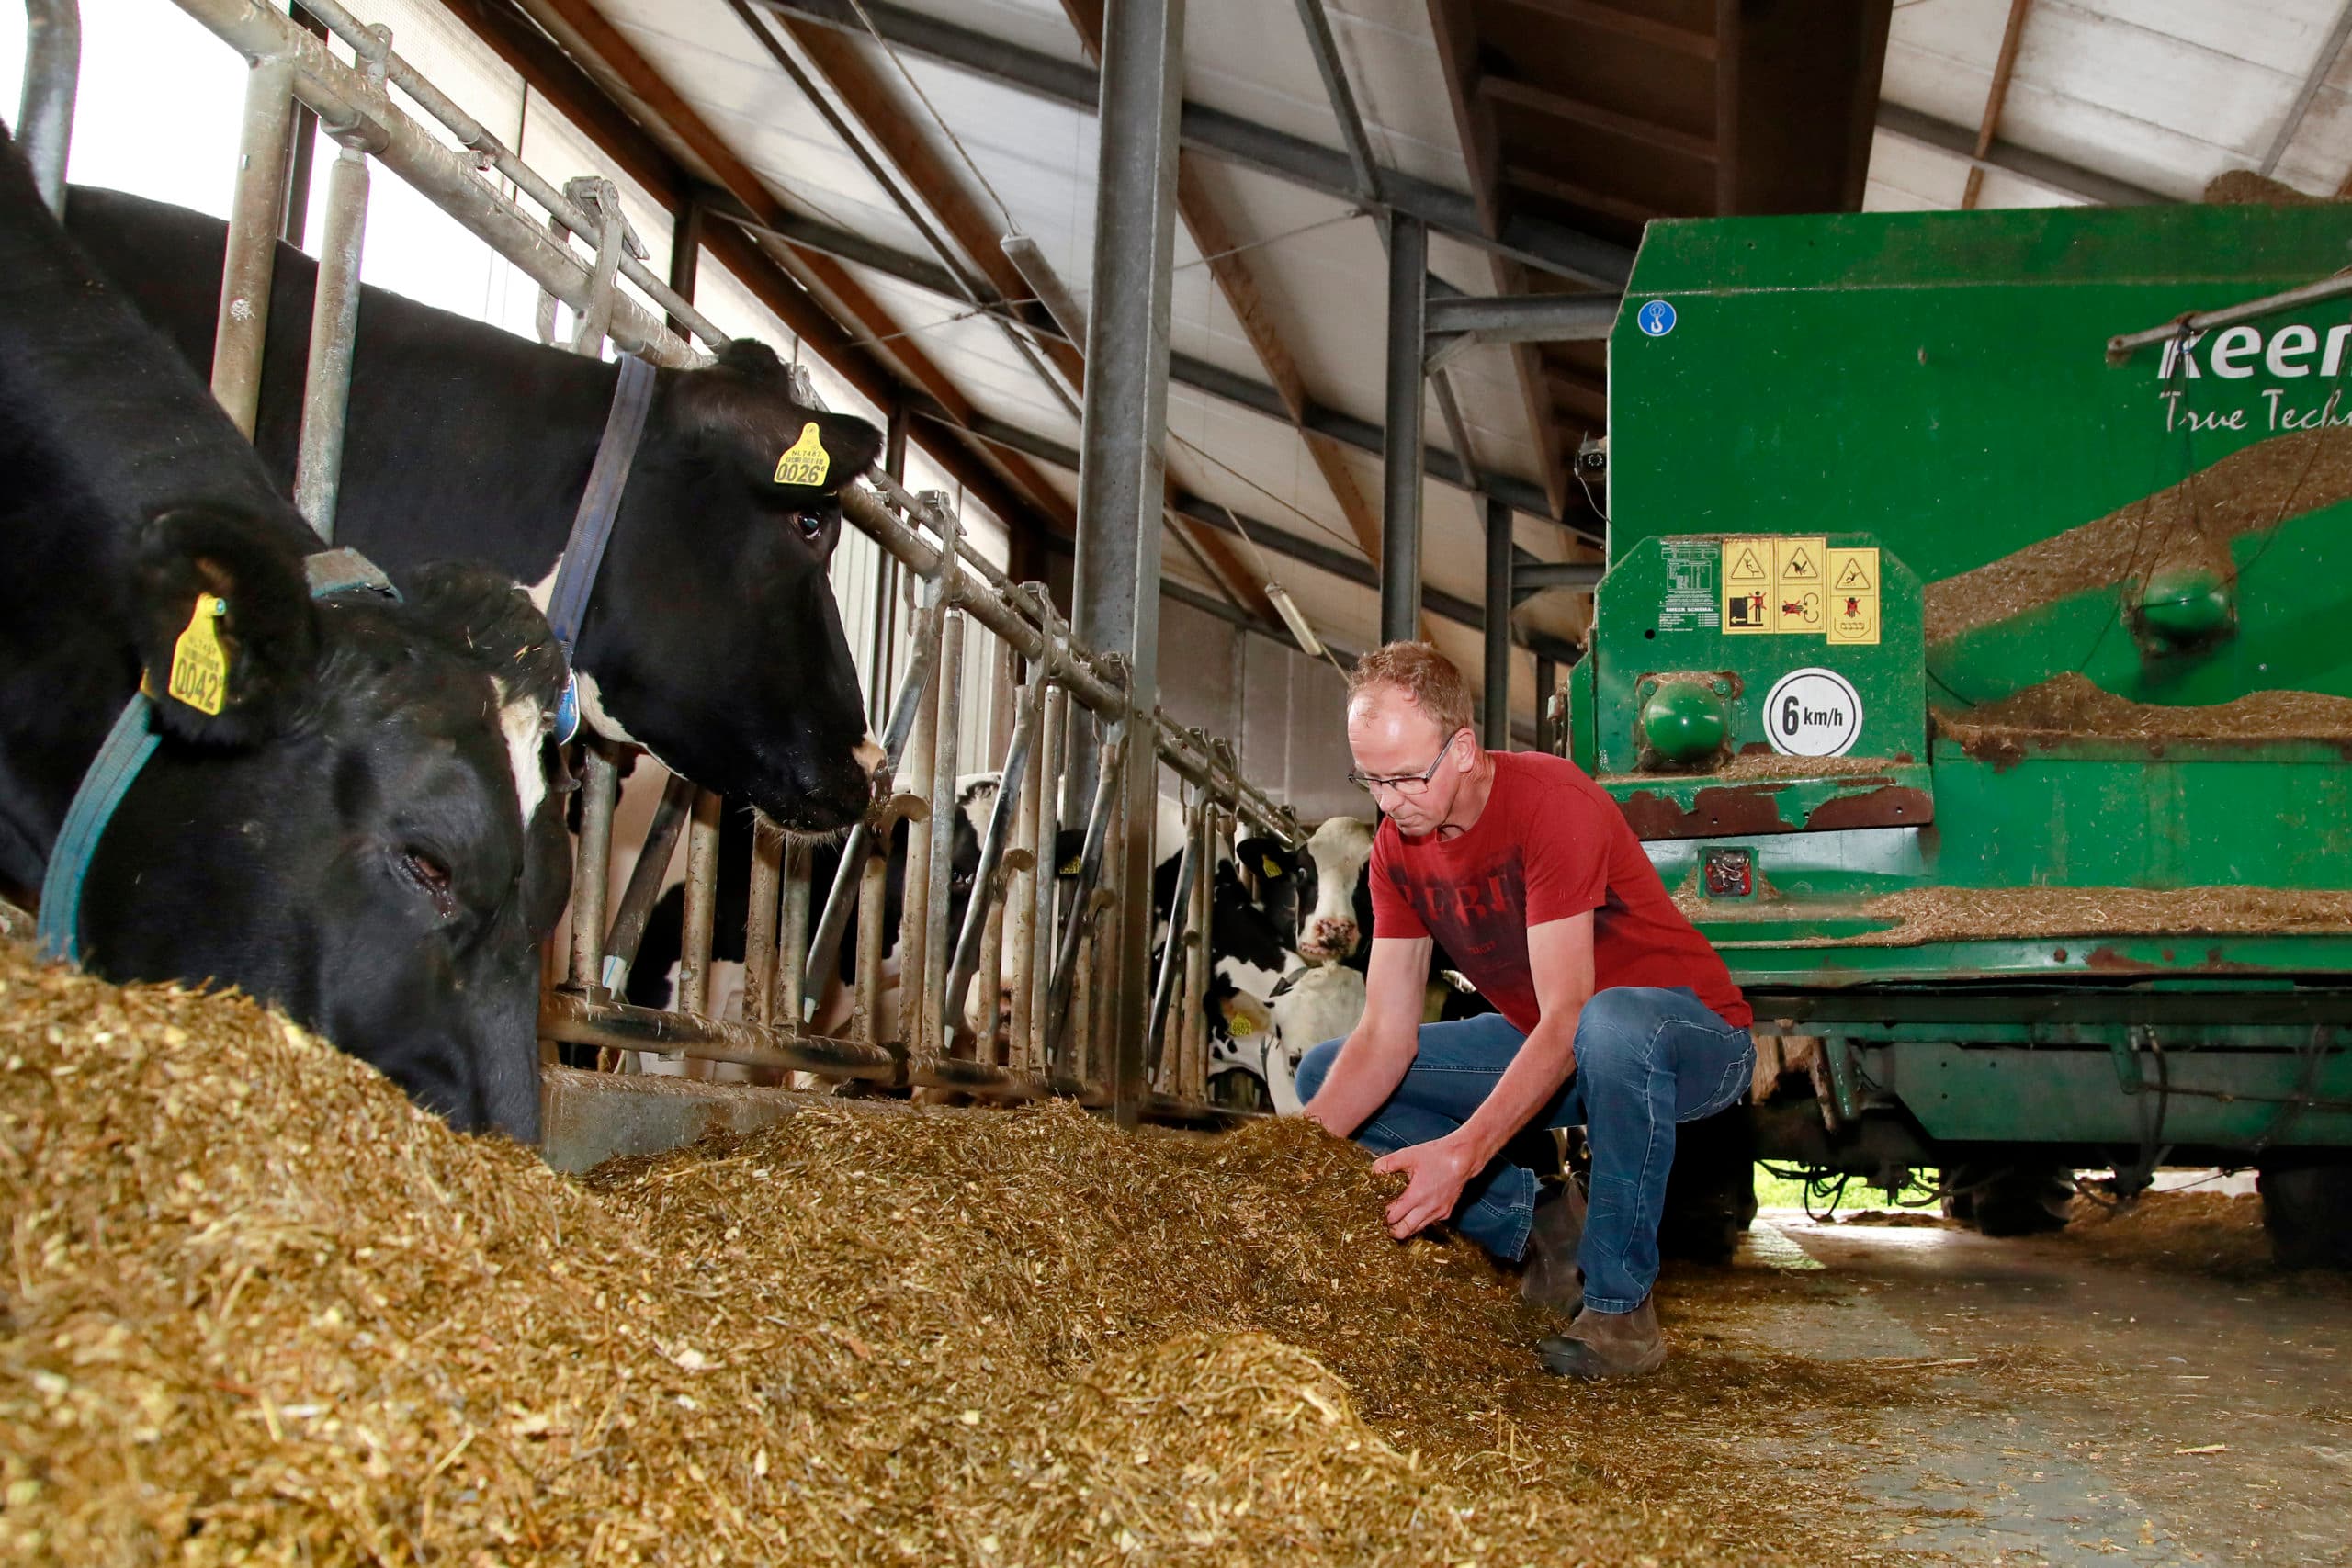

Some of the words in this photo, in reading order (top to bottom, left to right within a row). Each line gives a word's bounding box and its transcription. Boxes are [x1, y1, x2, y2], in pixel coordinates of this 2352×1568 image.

[2159, 390, 2248, 433] True
[2261, 389, 2352, 431] Tech
[776, 462, 820, 483] 0026
[175, 657, 217, 711] 0042
[1782, 695, 1800, 736] 6
[1804, 707, 1843, 728] km/h
